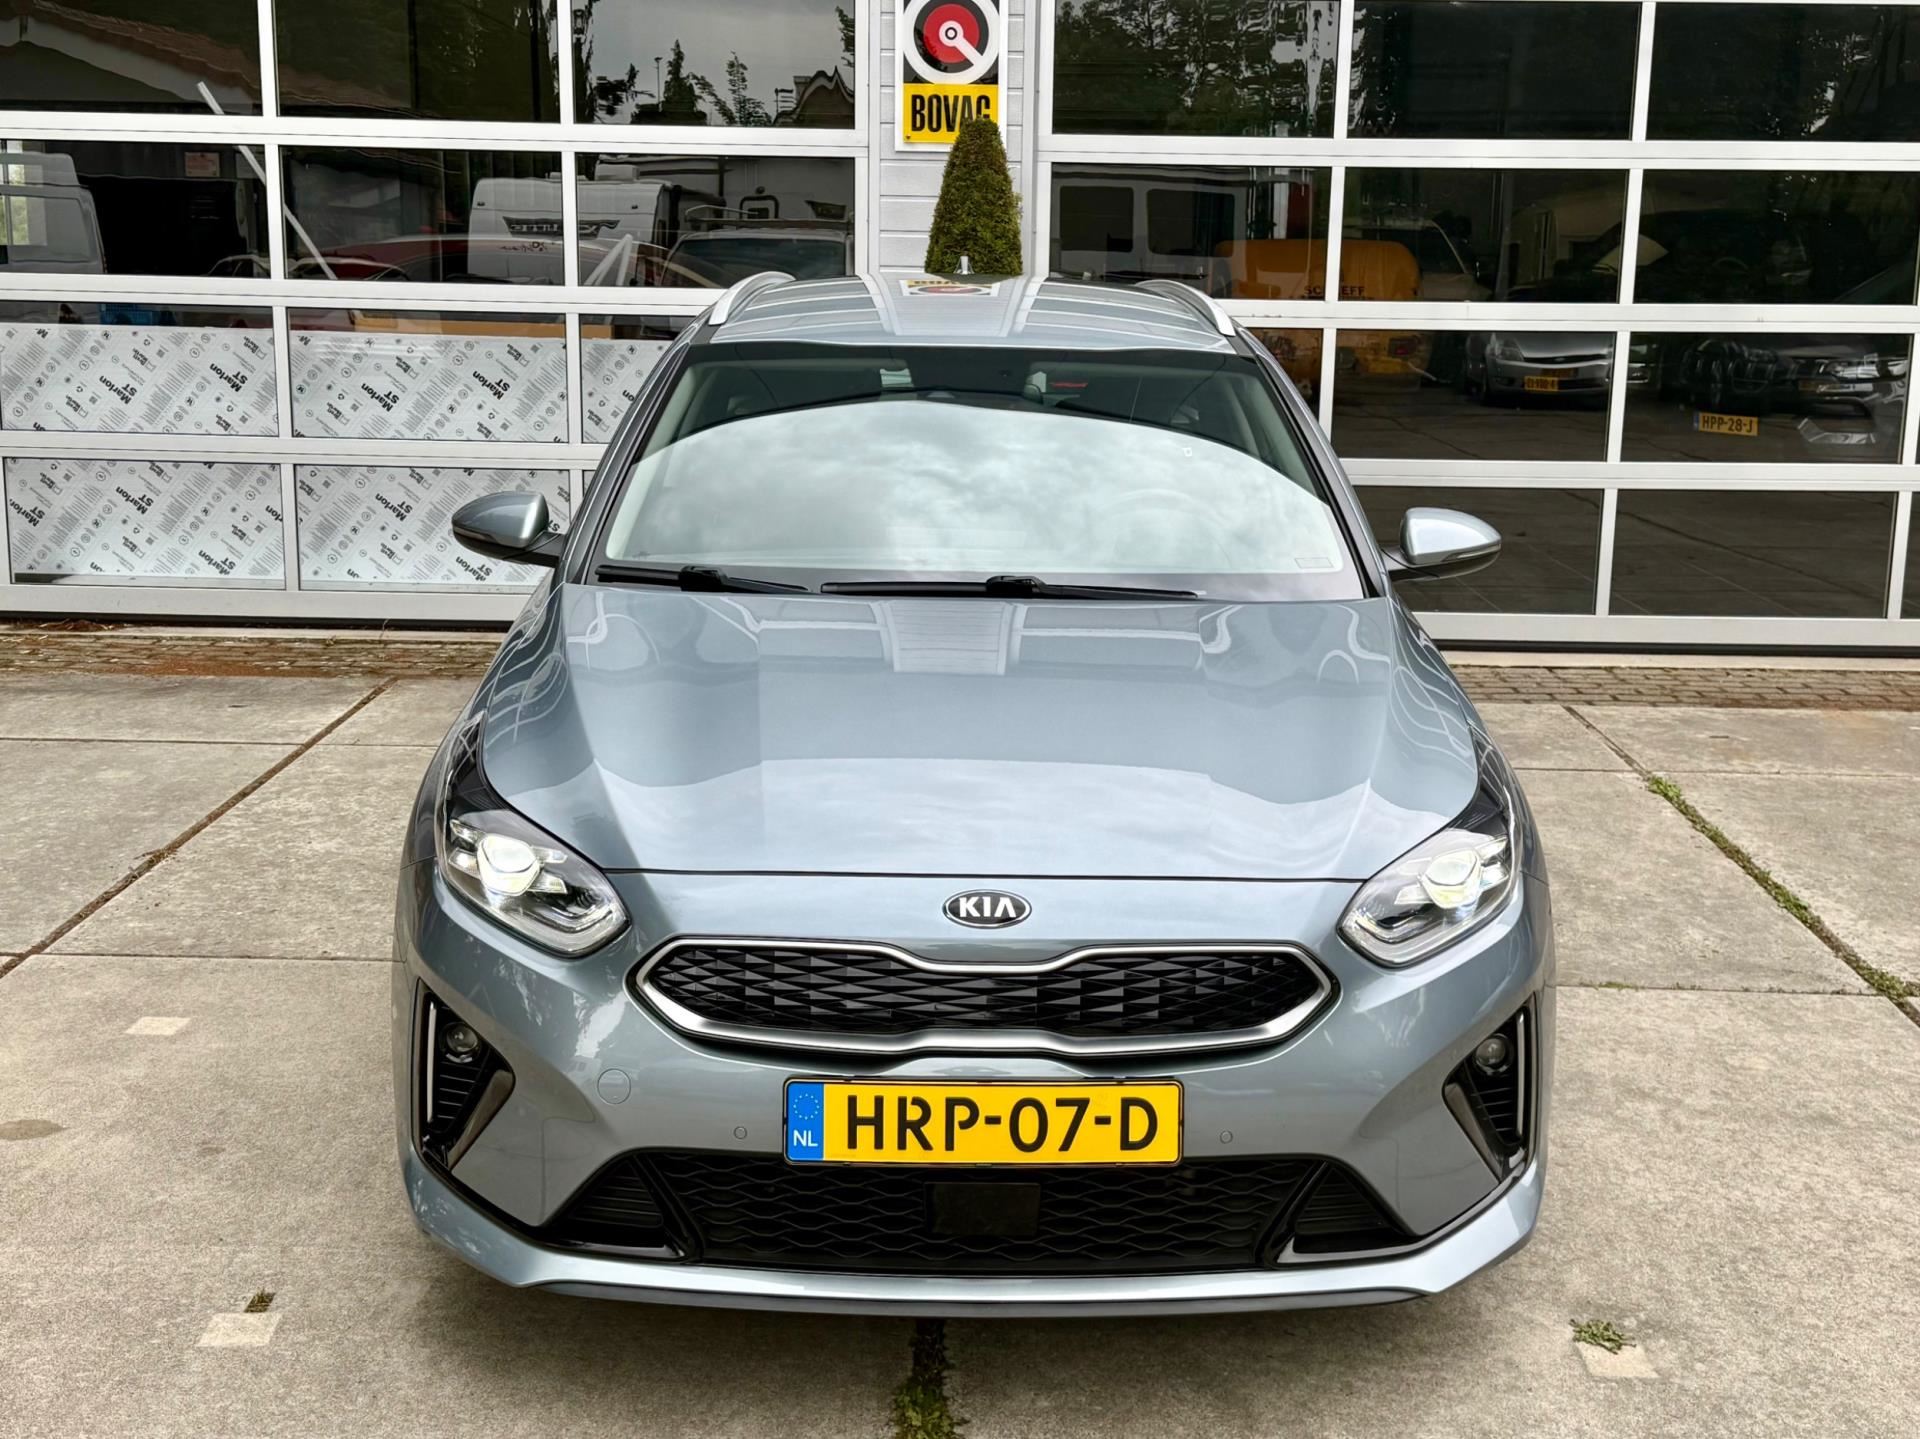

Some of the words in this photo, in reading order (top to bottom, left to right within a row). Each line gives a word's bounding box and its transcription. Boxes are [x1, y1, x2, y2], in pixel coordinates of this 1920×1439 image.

[210, 363, 242, 392] Marlon
[232, 371, 248, 385] ST
[472, 370, 505, 400] Marlon
[495, 379, 511, 392] ST
[99, 375, 132, 405] Marlon
[122, 384, 137, 397] ST
[361, 383, 394, 412] Marlon
[384, 391, 400, 404] ST
[1702, 415, 1753, 433] HPP-28-J
[115, 486, 148, 515] Marlon
[138, 494, 154, 507] ST
[375, 493, 408, 521] Marlon
[397, 501, 413, 514] ST
[30, 506, 46, 519] ST
[221, 557, 236, 570] ST
[477, 564, 493, 577] ST
[958, 896, 1017, 918] KIA
[847, 1094, 1158, 1153] HRP-07-D
[793, 1129, 818, 1147] NL
